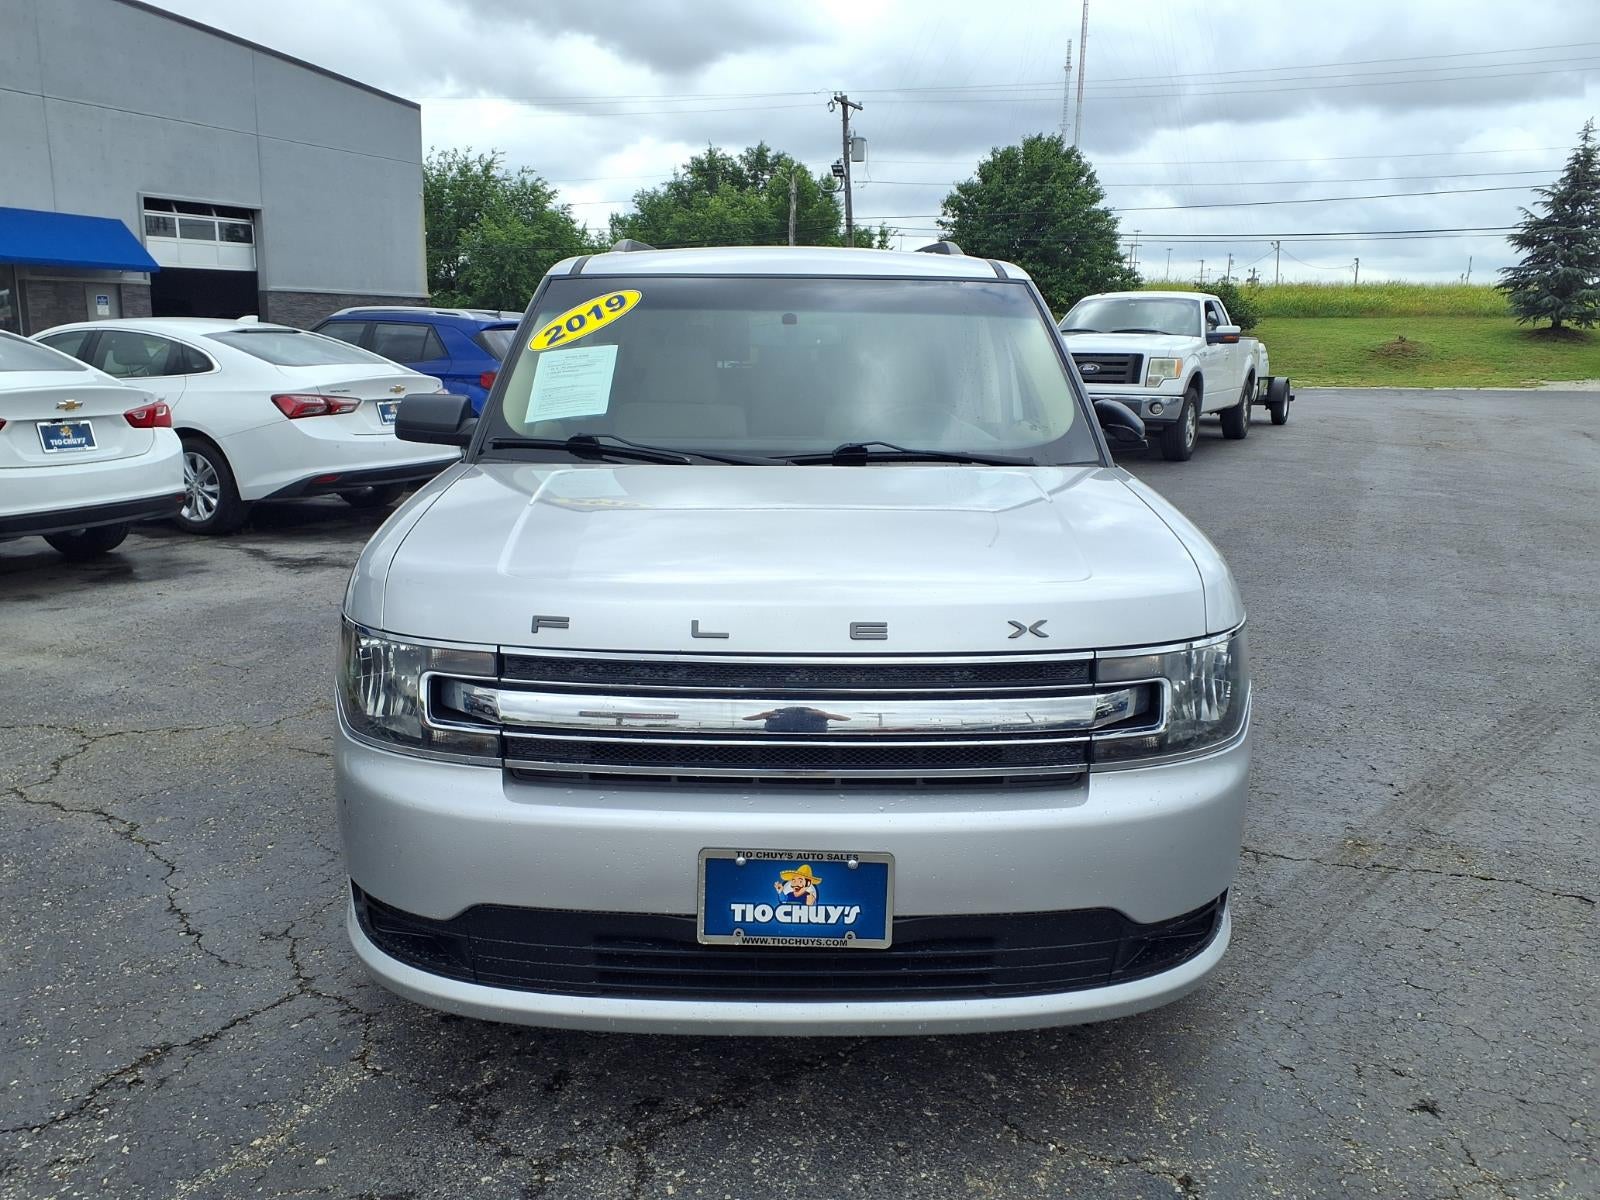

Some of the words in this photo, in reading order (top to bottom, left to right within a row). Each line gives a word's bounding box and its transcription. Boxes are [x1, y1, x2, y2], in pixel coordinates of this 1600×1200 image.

[544, 294, 626, 346] 2019
[735, 850, 753, 858] TIO
[756, 851, 794, 859] CHUY'S
[796, 852, 824, 860] AUTO
[826, 853, 859, 861] SALES
[741, 937, 848, 947] WWW.TIOCHUYS.COM
